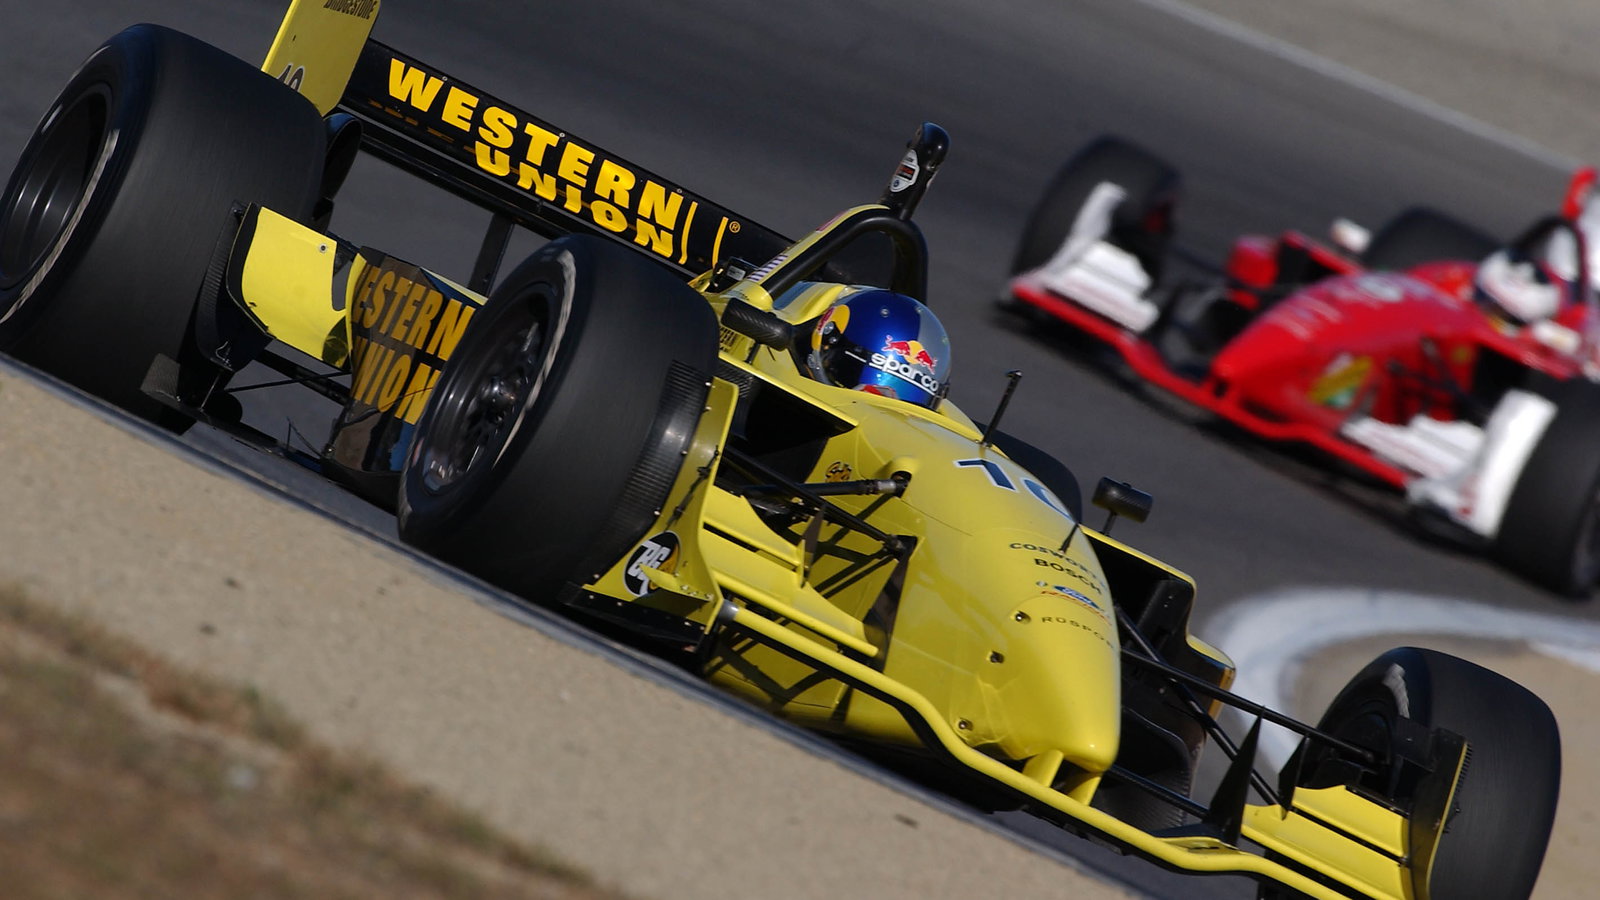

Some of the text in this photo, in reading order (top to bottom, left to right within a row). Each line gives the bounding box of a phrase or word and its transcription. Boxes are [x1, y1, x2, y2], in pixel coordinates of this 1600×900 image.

[388, 57, 684, 231] WESTERN
[474, 140, 674, 259] UNION
[352, 264, 476, 362] ESTERN
[352, 335, 441, 426] NION
[871, 352, 939, 392] sparco
[1033, 558, 1102, 596] BOSCH
